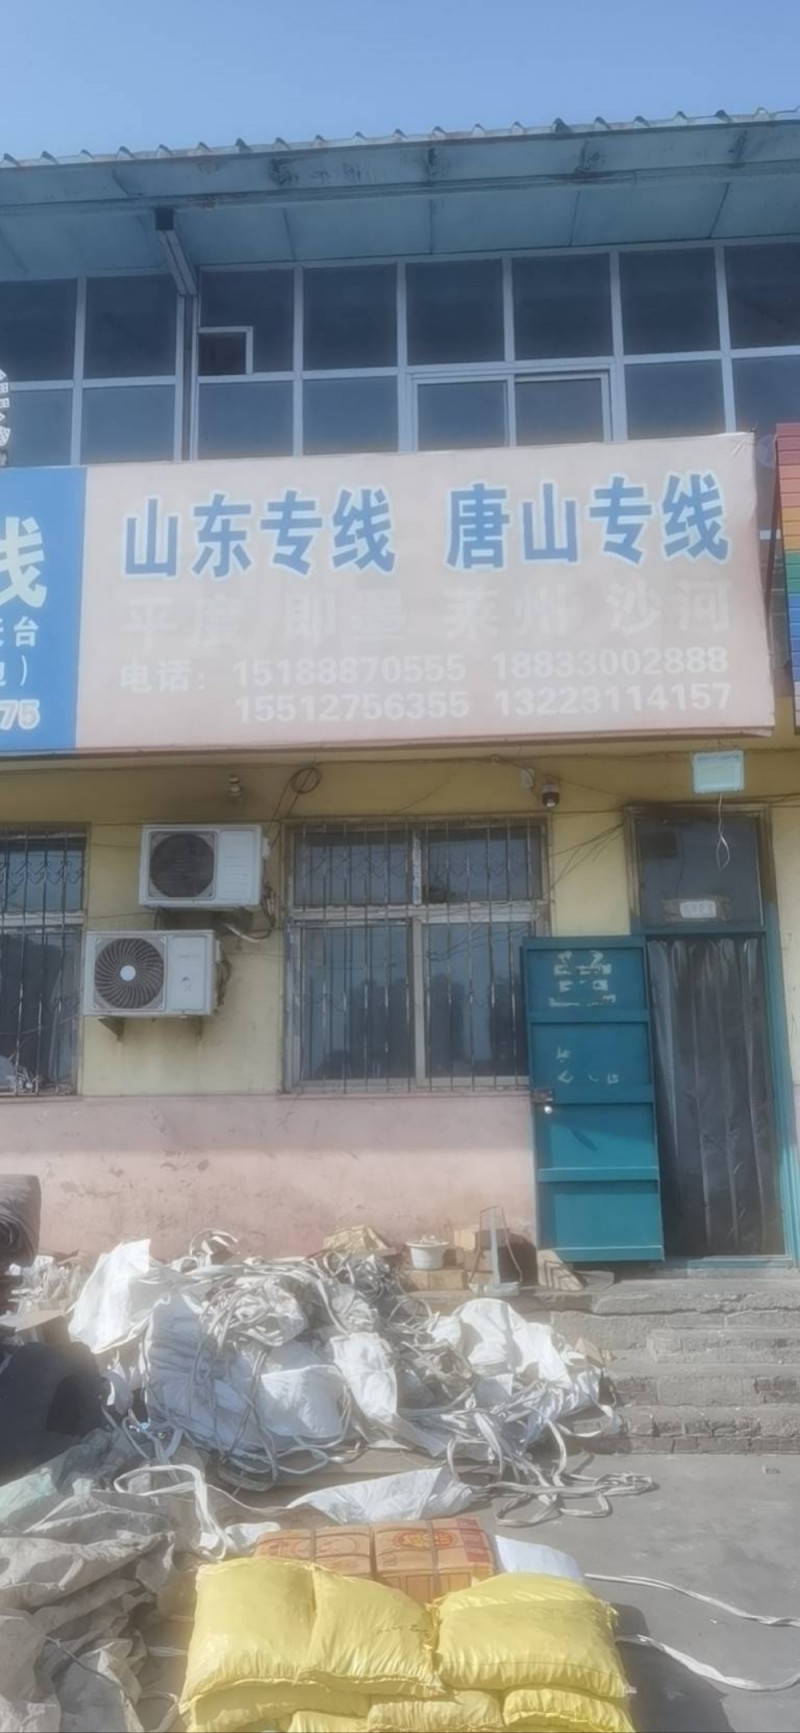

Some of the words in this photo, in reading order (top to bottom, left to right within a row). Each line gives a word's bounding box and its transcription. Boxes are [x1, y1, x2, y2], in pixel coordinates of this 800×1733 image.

[121, 486, 398, 580] 山东专线
[445, 471, 732, 571] 唐山专线
[122, 594, 243, 651] 平度
[443, 580, 570, 641] 莱州
[606, 577, 732, 635] 沙河
[233, 653, 467, 688] 15188870555
[491, 646, 730, 680] 18833002888
[234, 691, 471, 723] 15512756355
[494, 683, 733, 717] 13223114157
